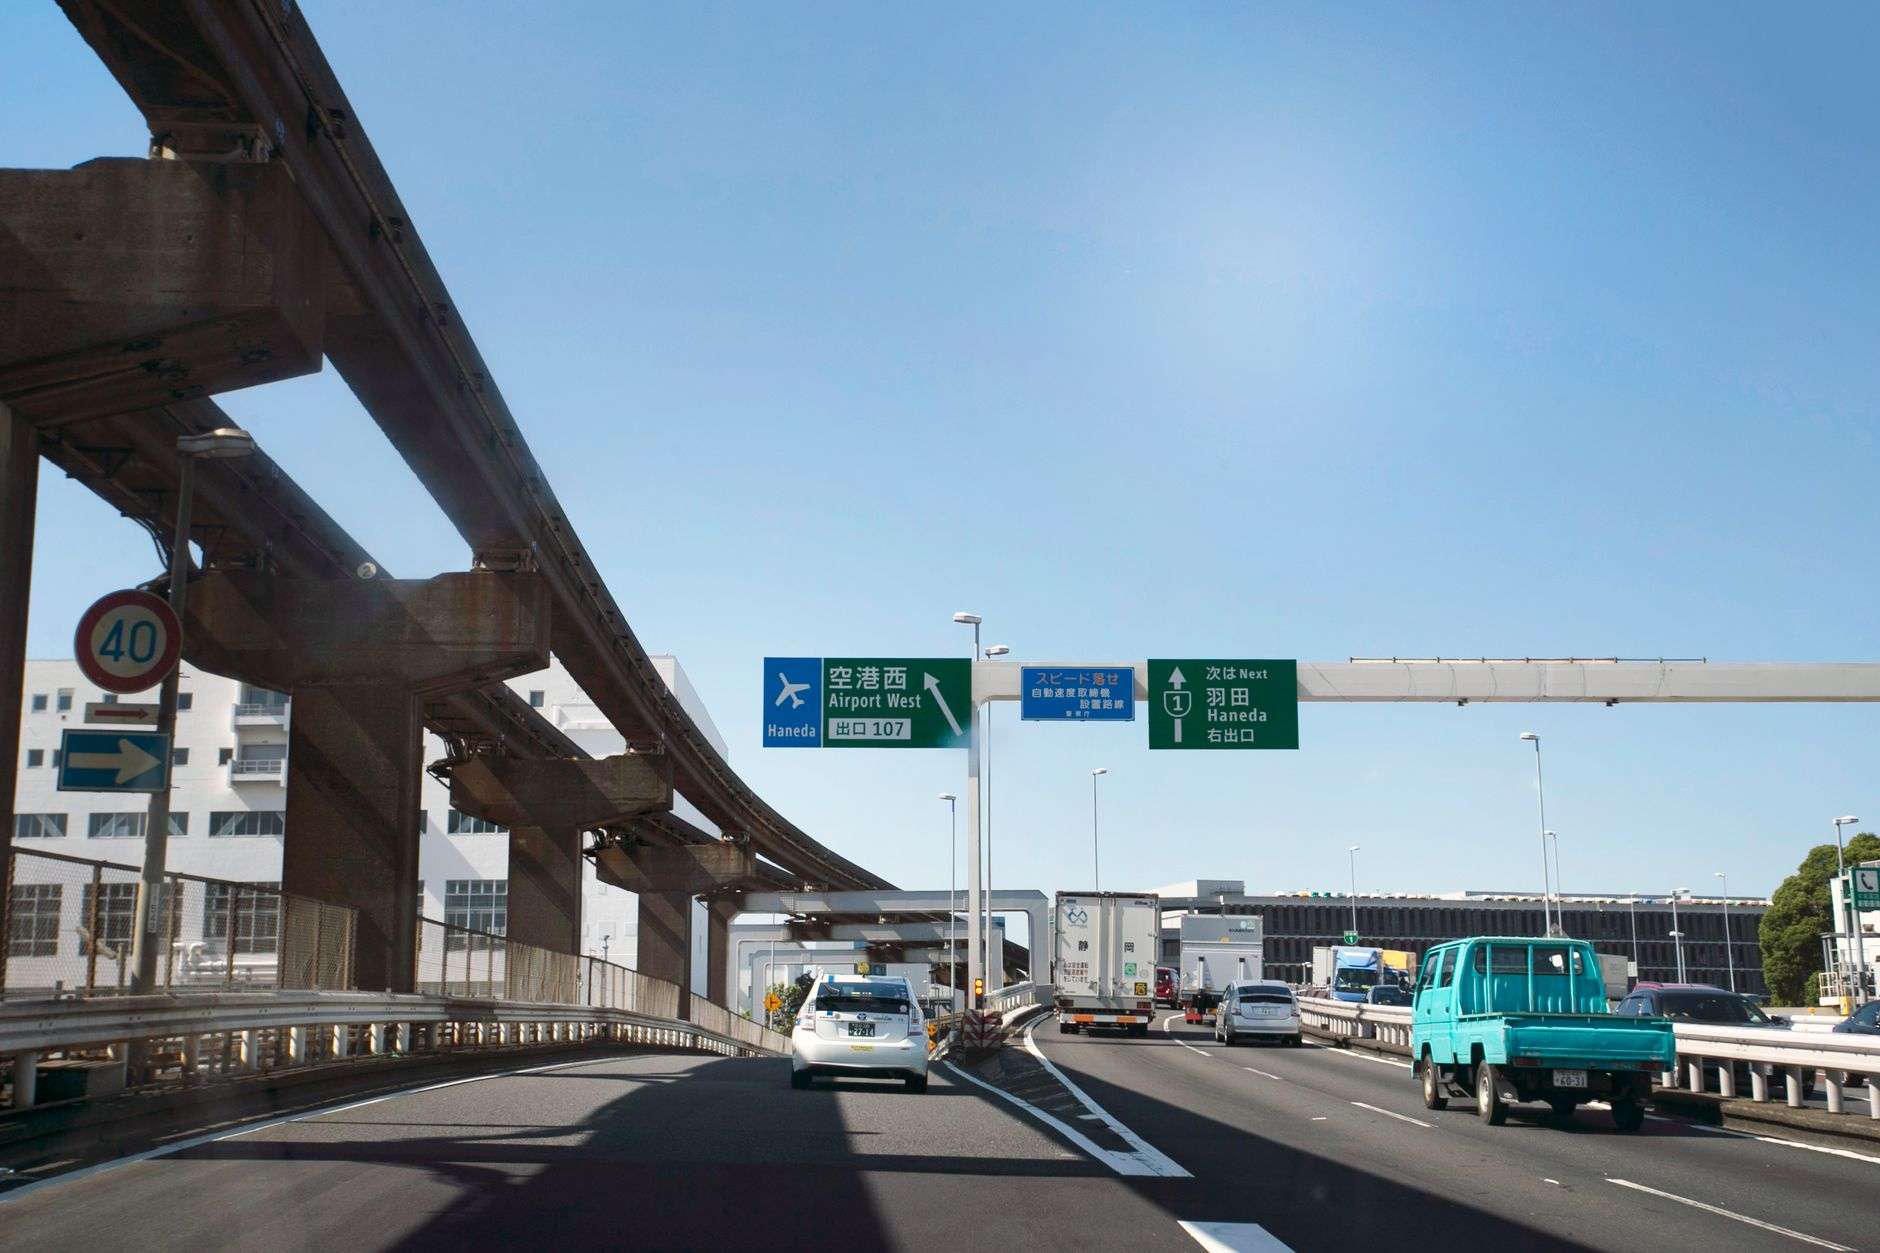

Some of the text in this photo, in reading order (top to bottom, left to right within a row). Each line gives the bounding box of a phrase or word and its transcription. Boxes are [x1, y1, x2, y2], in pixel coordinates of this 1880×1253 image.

[99, 619, 157, 663] 40
[829, 666, 907, 690] 空港西
[1206, 666, 1268, 680] 次は Next
[829, 693, 921, 711] Airport West
[1172, 695, 1183, 711] 1
[1206, 687, 1248, 706] 羽田
[1207, 708, 1267, 722] Haneda
[768, 723, 816, 737] Haneda
[836, 721, 904, 736] 出口 107
[1207, 728, 1254, 742] 右出口
